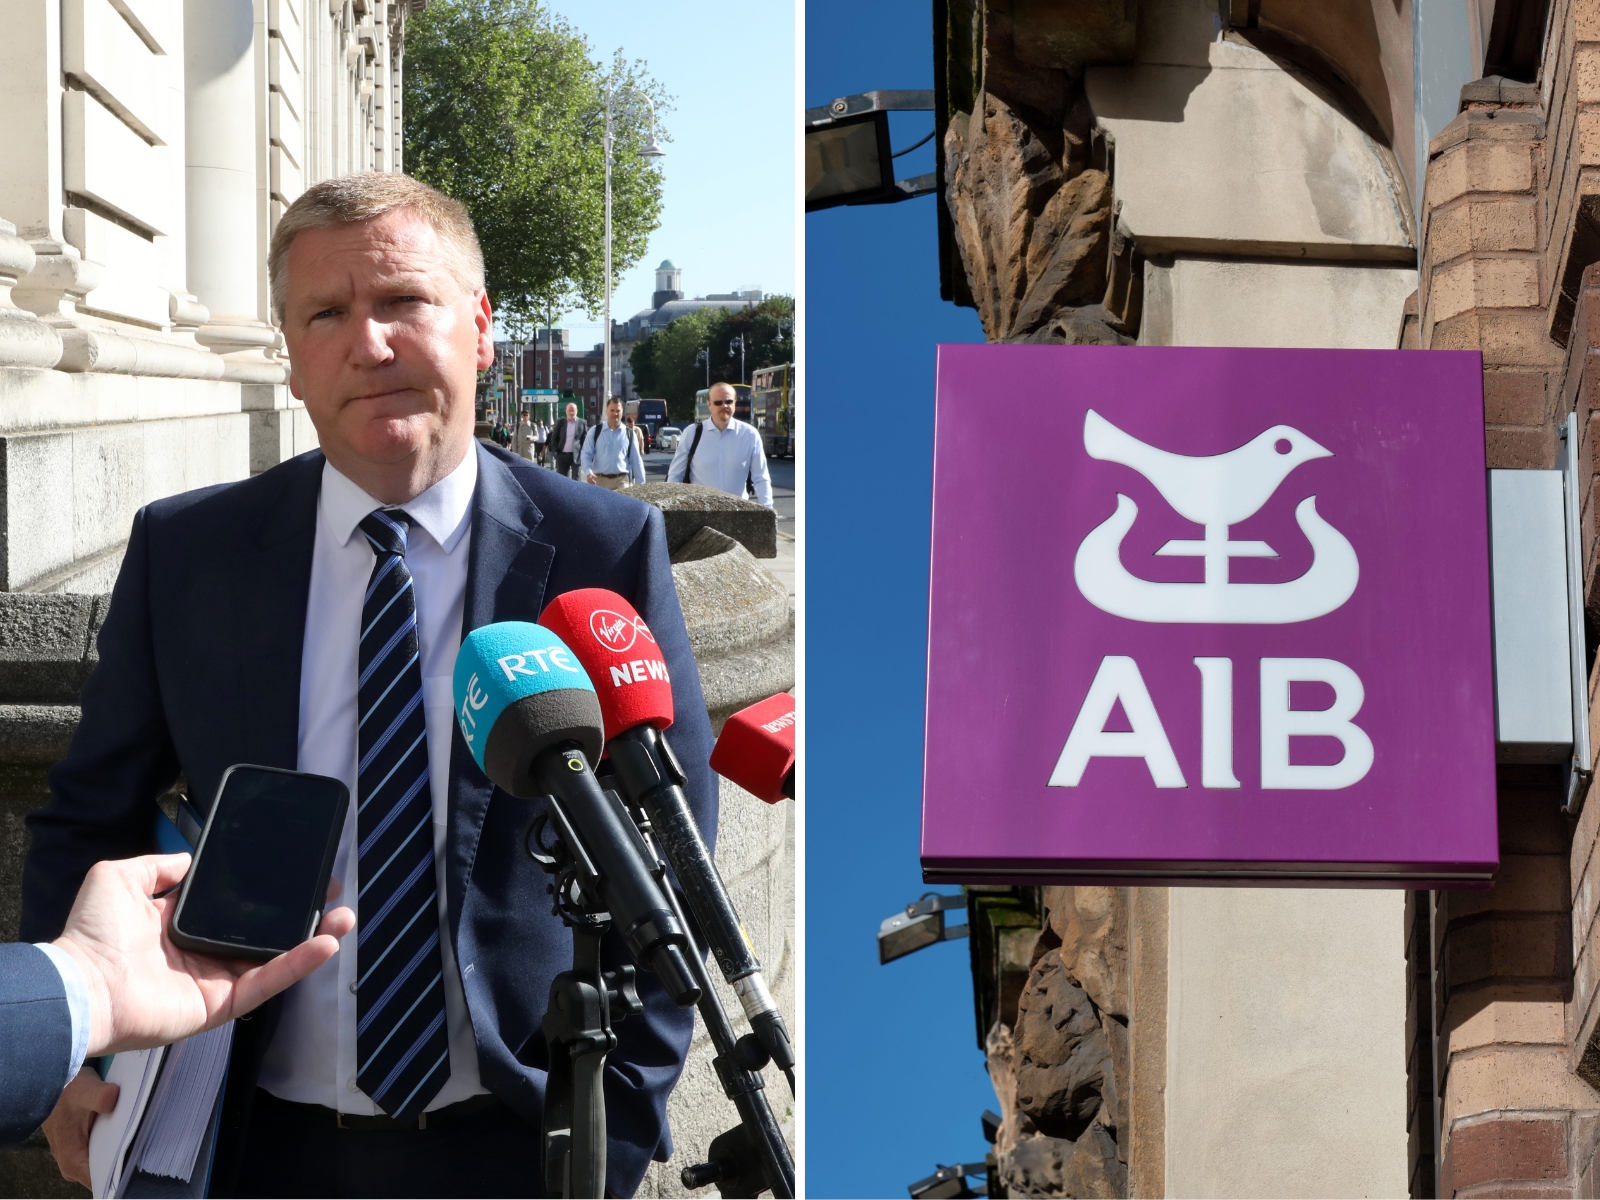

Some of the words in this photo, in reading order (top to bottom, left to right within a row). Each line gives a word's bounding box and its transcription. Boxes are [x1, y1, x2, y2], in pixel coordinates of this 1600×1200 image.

[599, 616, 627, 643] Virgin
[497, 646, 580, 682] RTÉ
[609, 659, 671, 688] NEWS
[1046, 655, 1375, 790] AIB
